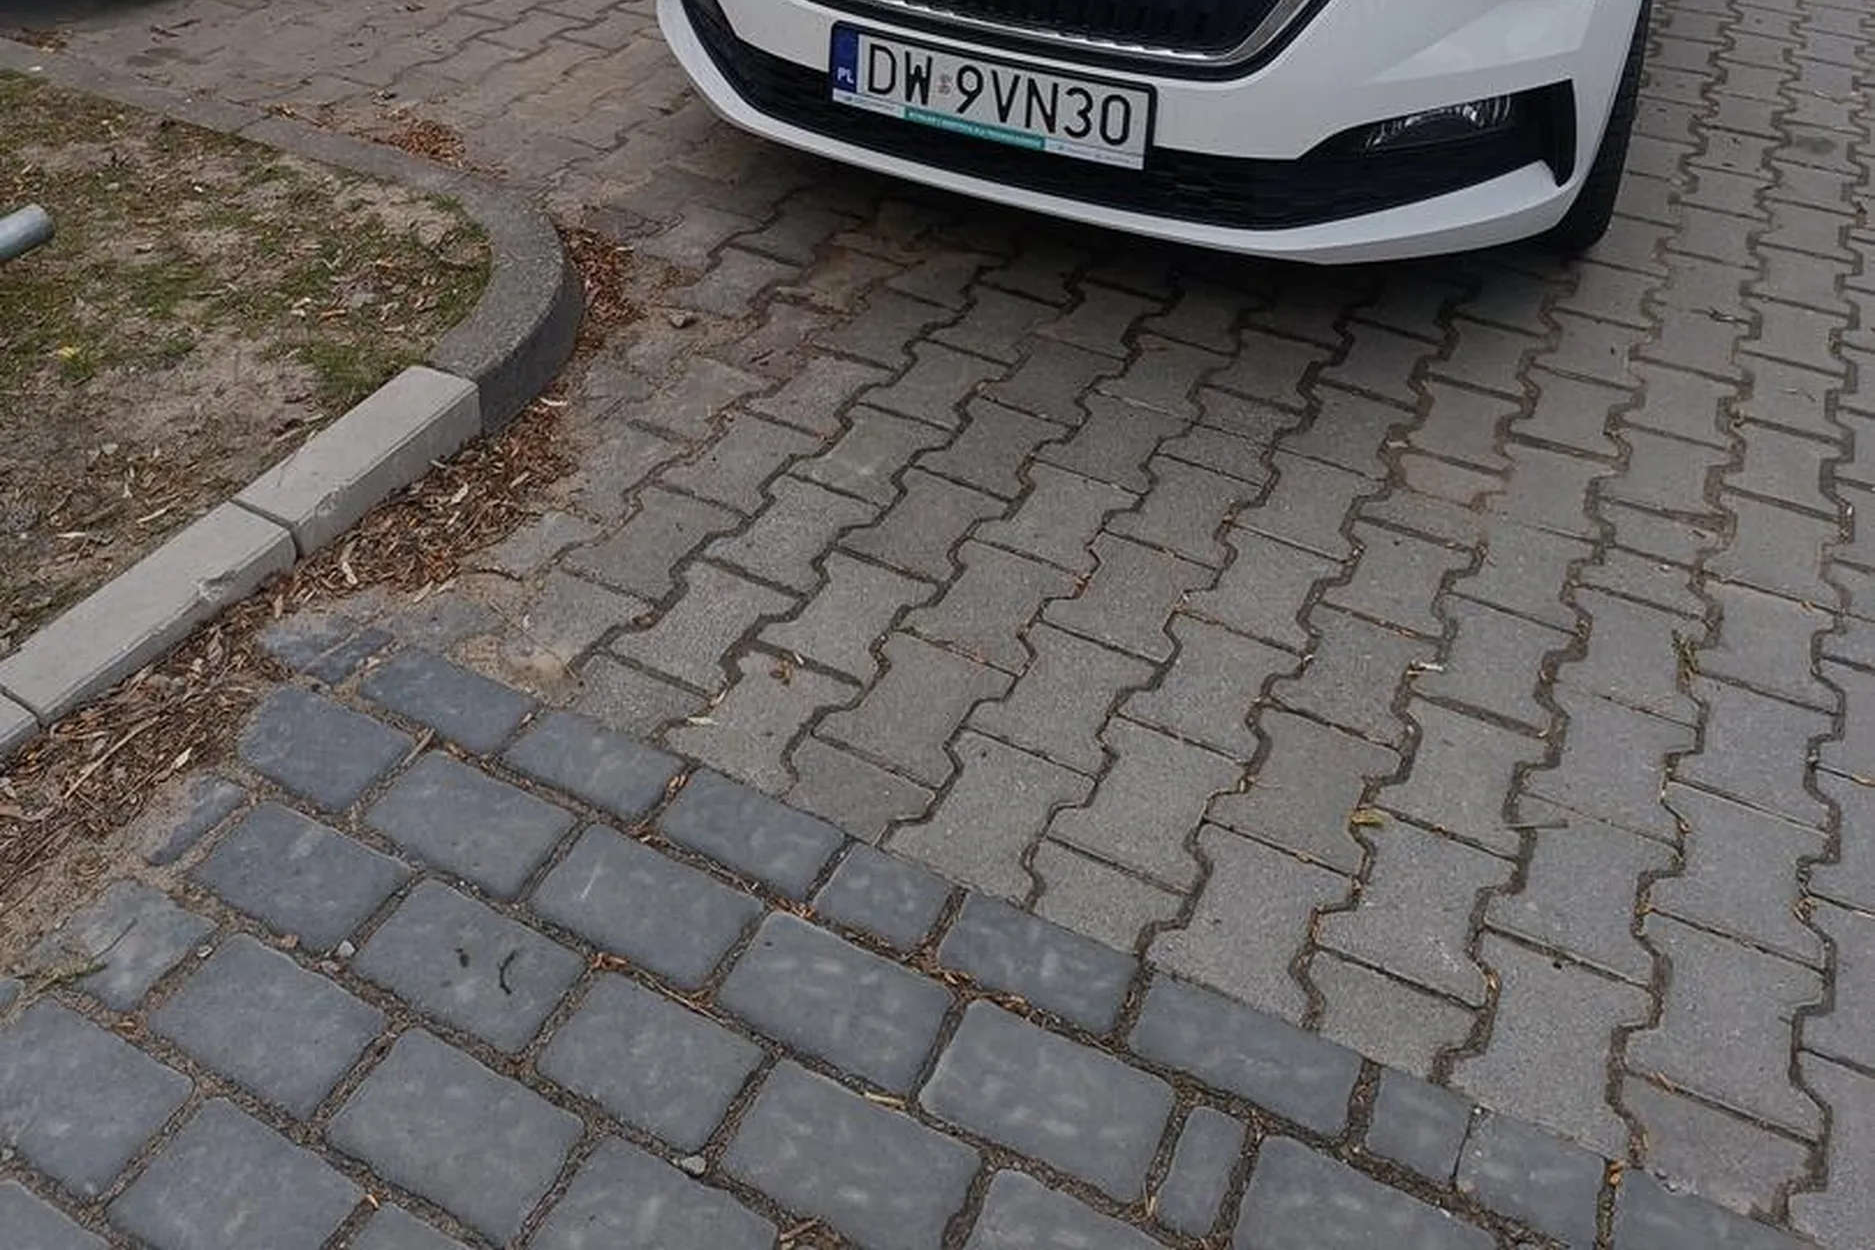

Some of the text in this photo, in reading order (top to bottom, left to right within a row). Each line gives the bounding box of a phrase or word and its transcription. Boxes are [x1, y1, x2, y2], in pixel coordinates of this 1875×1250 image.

[836, 67, 855, 84] PL
[867, 42, 933, 107] DW
[956, 64, 1132, 146] 9VN30
